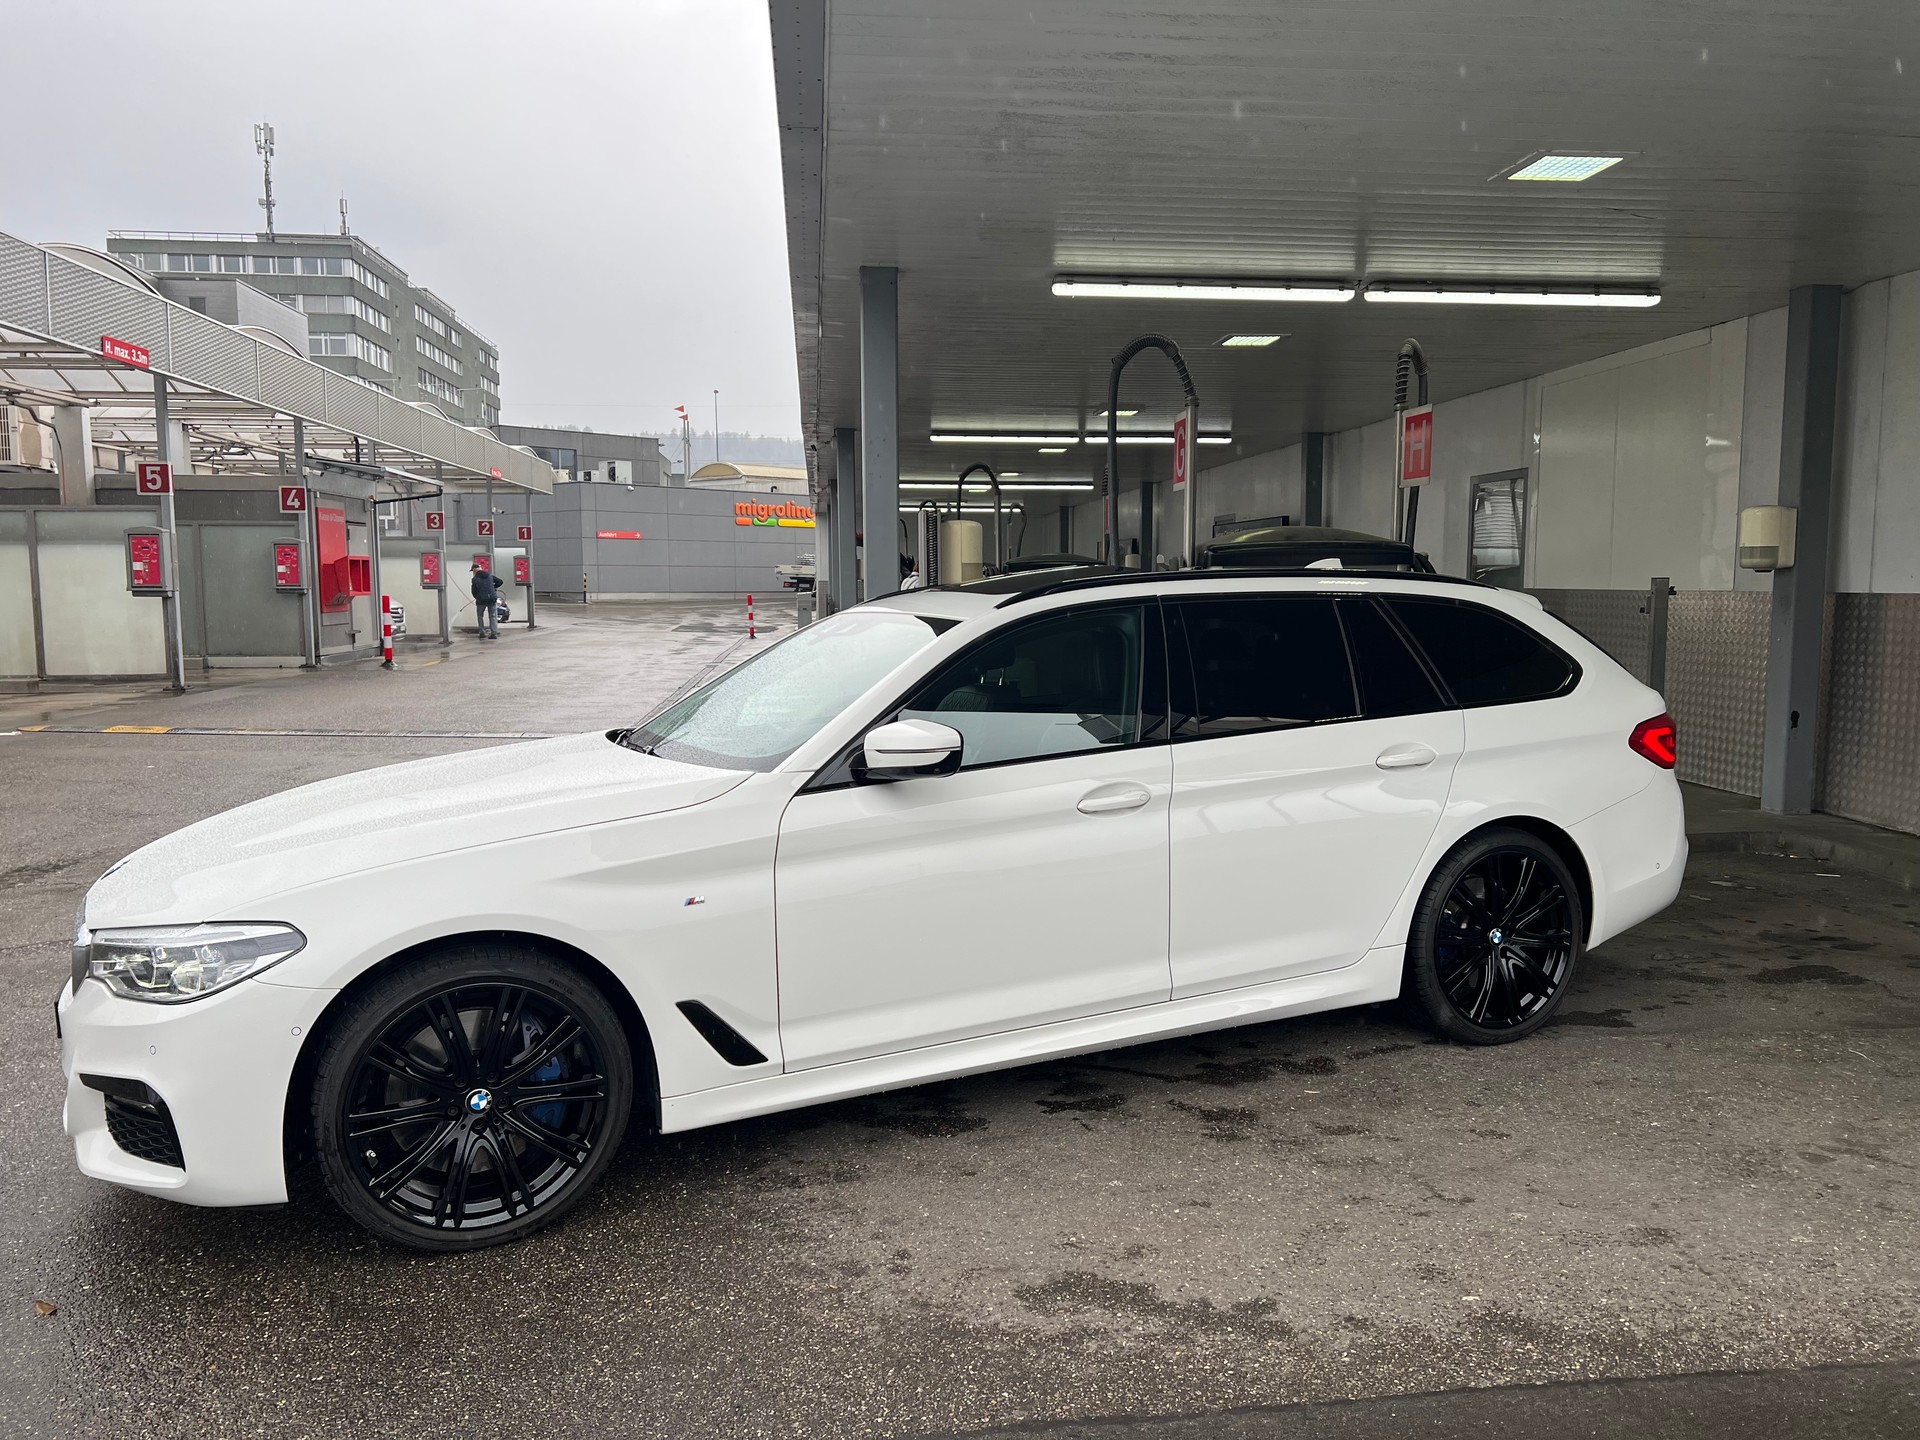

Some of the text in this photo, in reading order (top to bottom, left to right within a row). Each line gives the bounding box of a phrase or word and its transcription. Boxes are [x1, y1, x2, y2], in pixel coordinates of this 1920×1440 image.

[105, 340, 148, 365] H. max. 3.3m
[1176, 426, 1185, 478] G
[1408, 419, 1427, 473] H
[146, 466, 162, 490] 5
[286, 489, 300, 509] 4
[430, 514, 440, 528] 3
[481, 522, 490, 535] 2
[521, 528, 527, 539] 1
